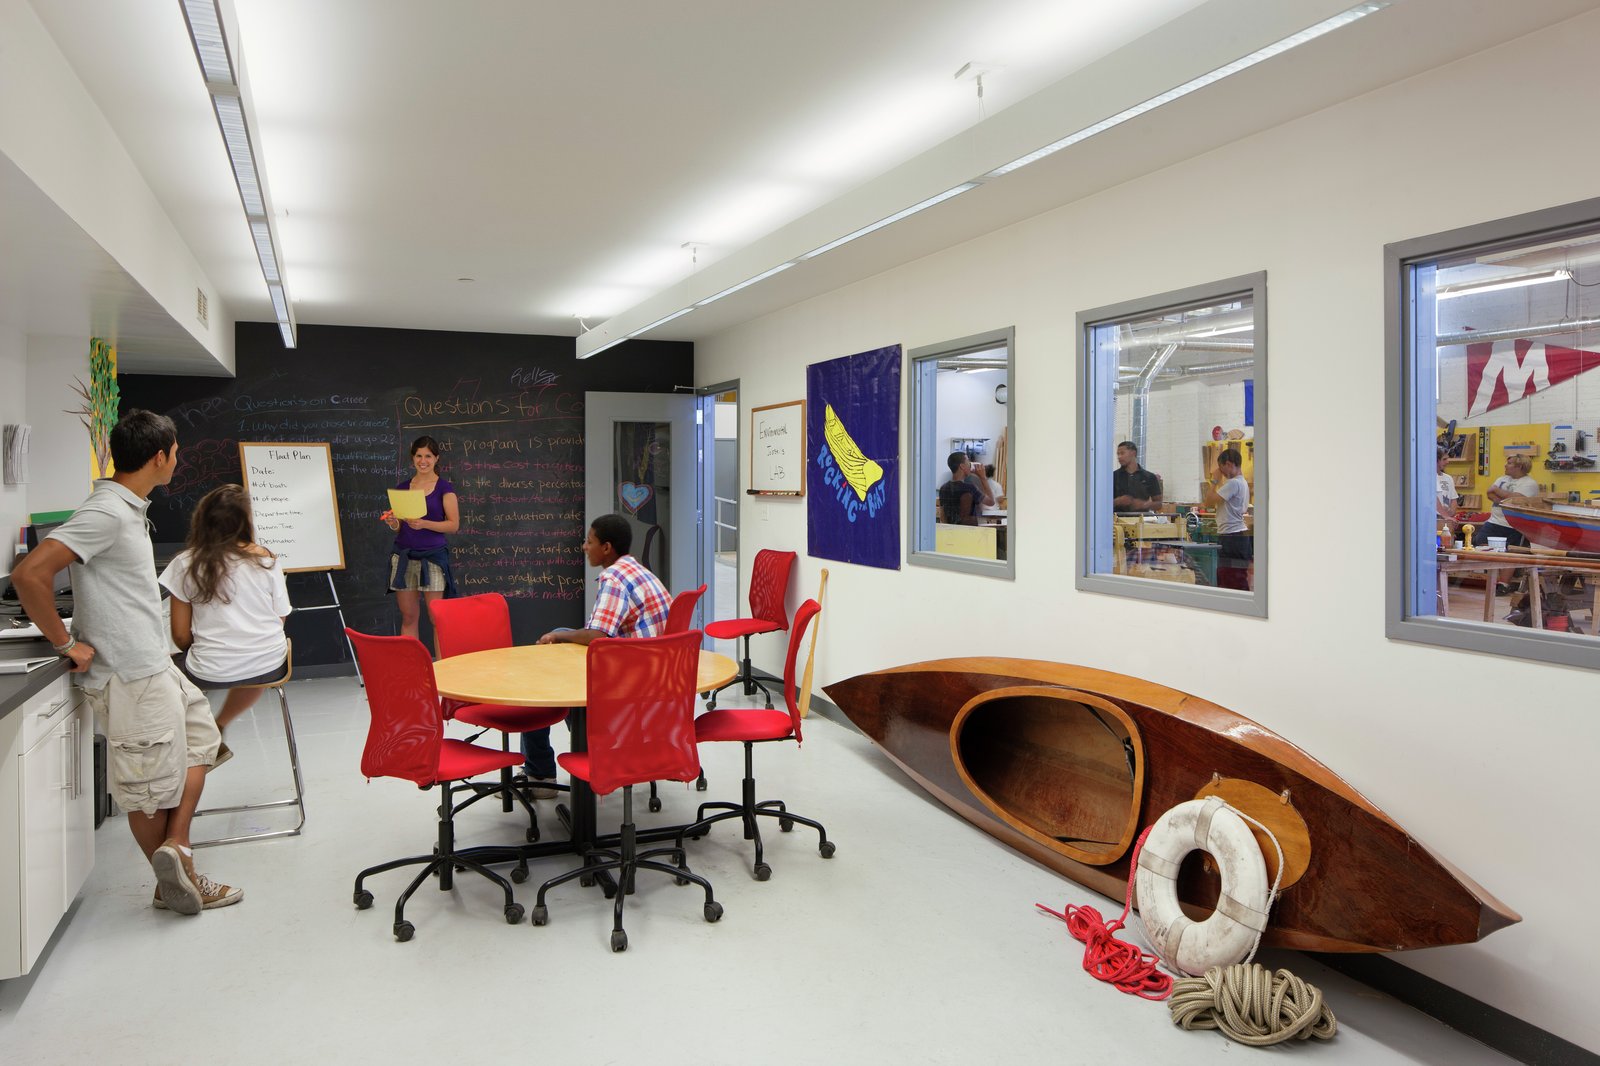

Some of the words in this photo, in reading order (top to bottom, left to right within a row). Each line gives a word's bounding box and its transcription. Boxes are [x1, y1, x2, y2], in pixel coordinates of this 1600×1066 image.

[404, 396, 509, 419] Questions
[515, 392, 544, 416] for
[555, 393, 584, 413] Co
[463, 439, 521, 456] program
[529, 435, 543, 448] is
[268, 450, 290, 461] Float
[292, 450, 312, 460] Plan
[350, 464, 367, 474] the
[462, 478, 471, 488] is
[475, 477, 492, 489] the
[499, 476, 536, 489] diverse
[867, 479, 886, 518] BOAT
[463, 509, 486, 524] the
[493, 511, 554, 527] graduation
[451, 543, 480, 558] quick
[484, 547, 505, 555] can
[512, 545, 531, 557] you
[536, 543, 561, 554] start
[464, 573, 489, 586] have
[508, 571, 555, 586] graduate
